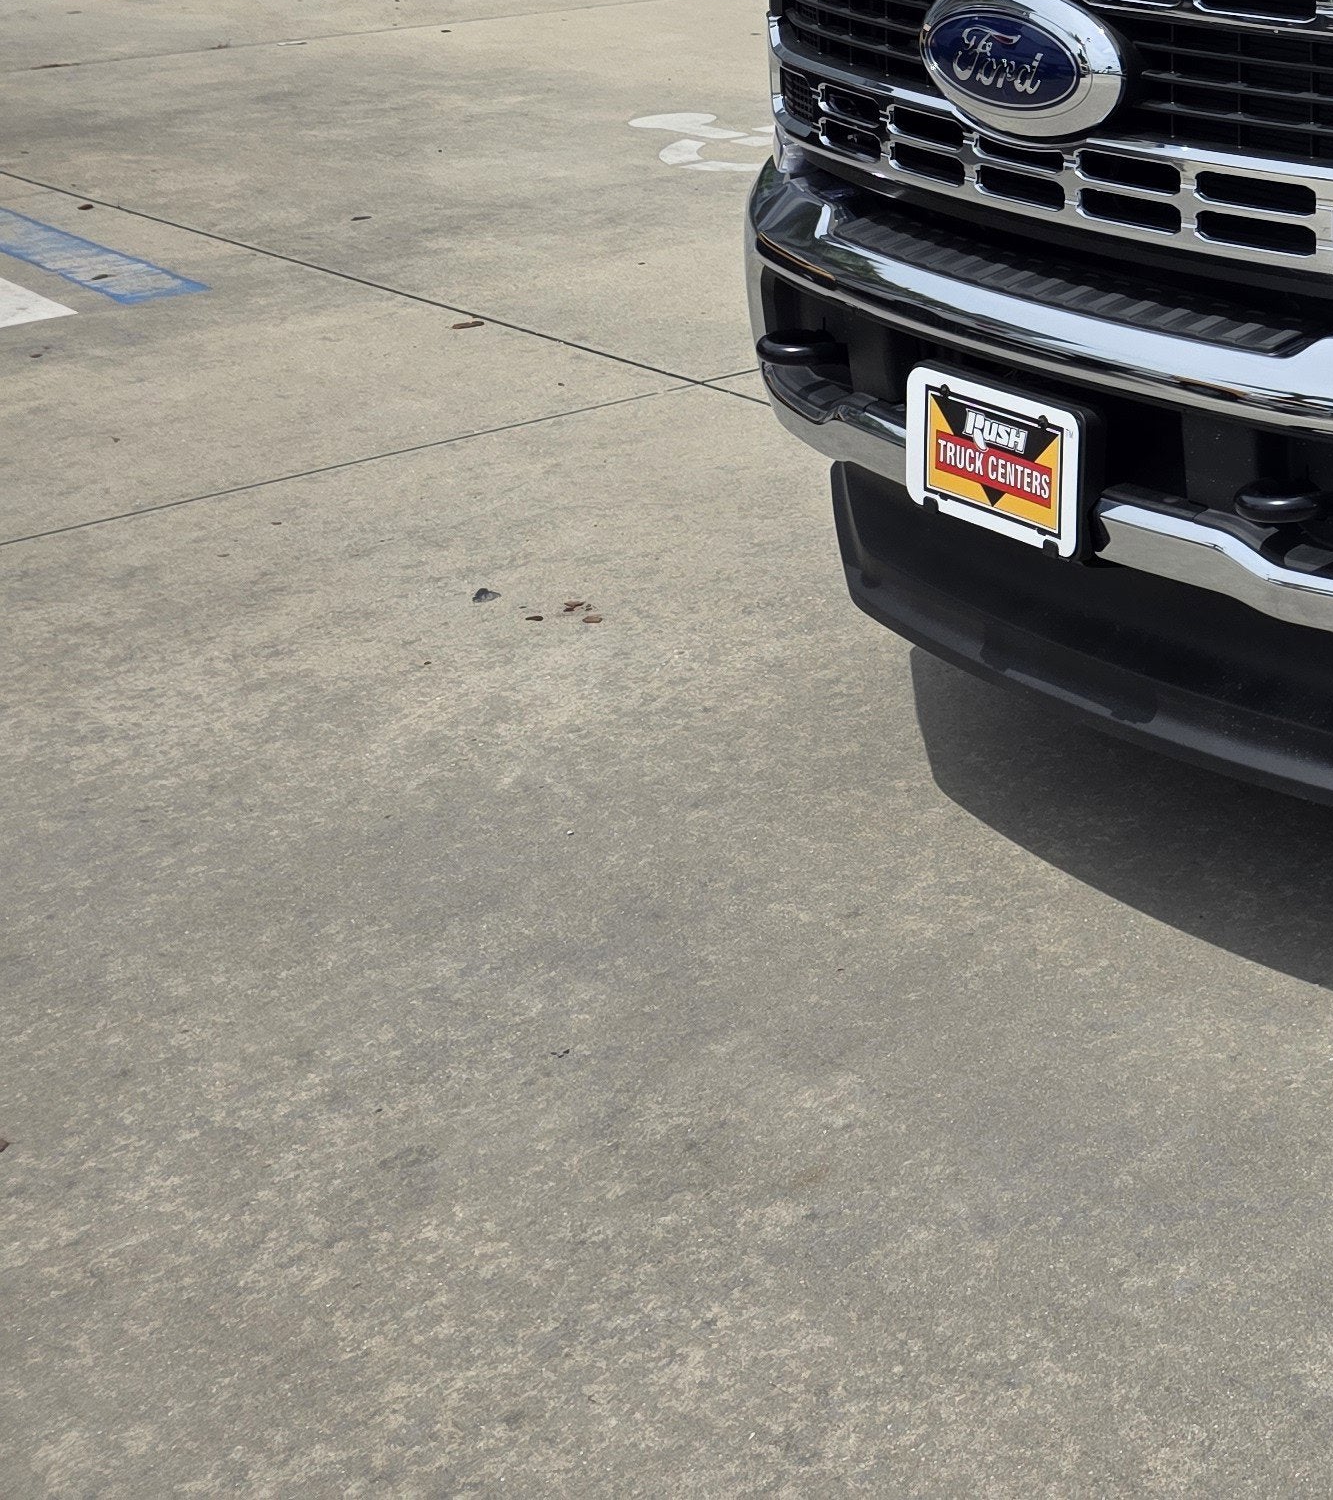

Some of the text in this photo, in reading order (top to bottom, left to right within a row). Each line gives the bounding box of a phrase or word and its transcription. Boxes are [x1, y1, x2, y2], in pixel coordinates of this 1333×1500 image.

[952, 24, 1042, 97] Ford
[937, 438, 1050, 499] TRUCK CENTERS
